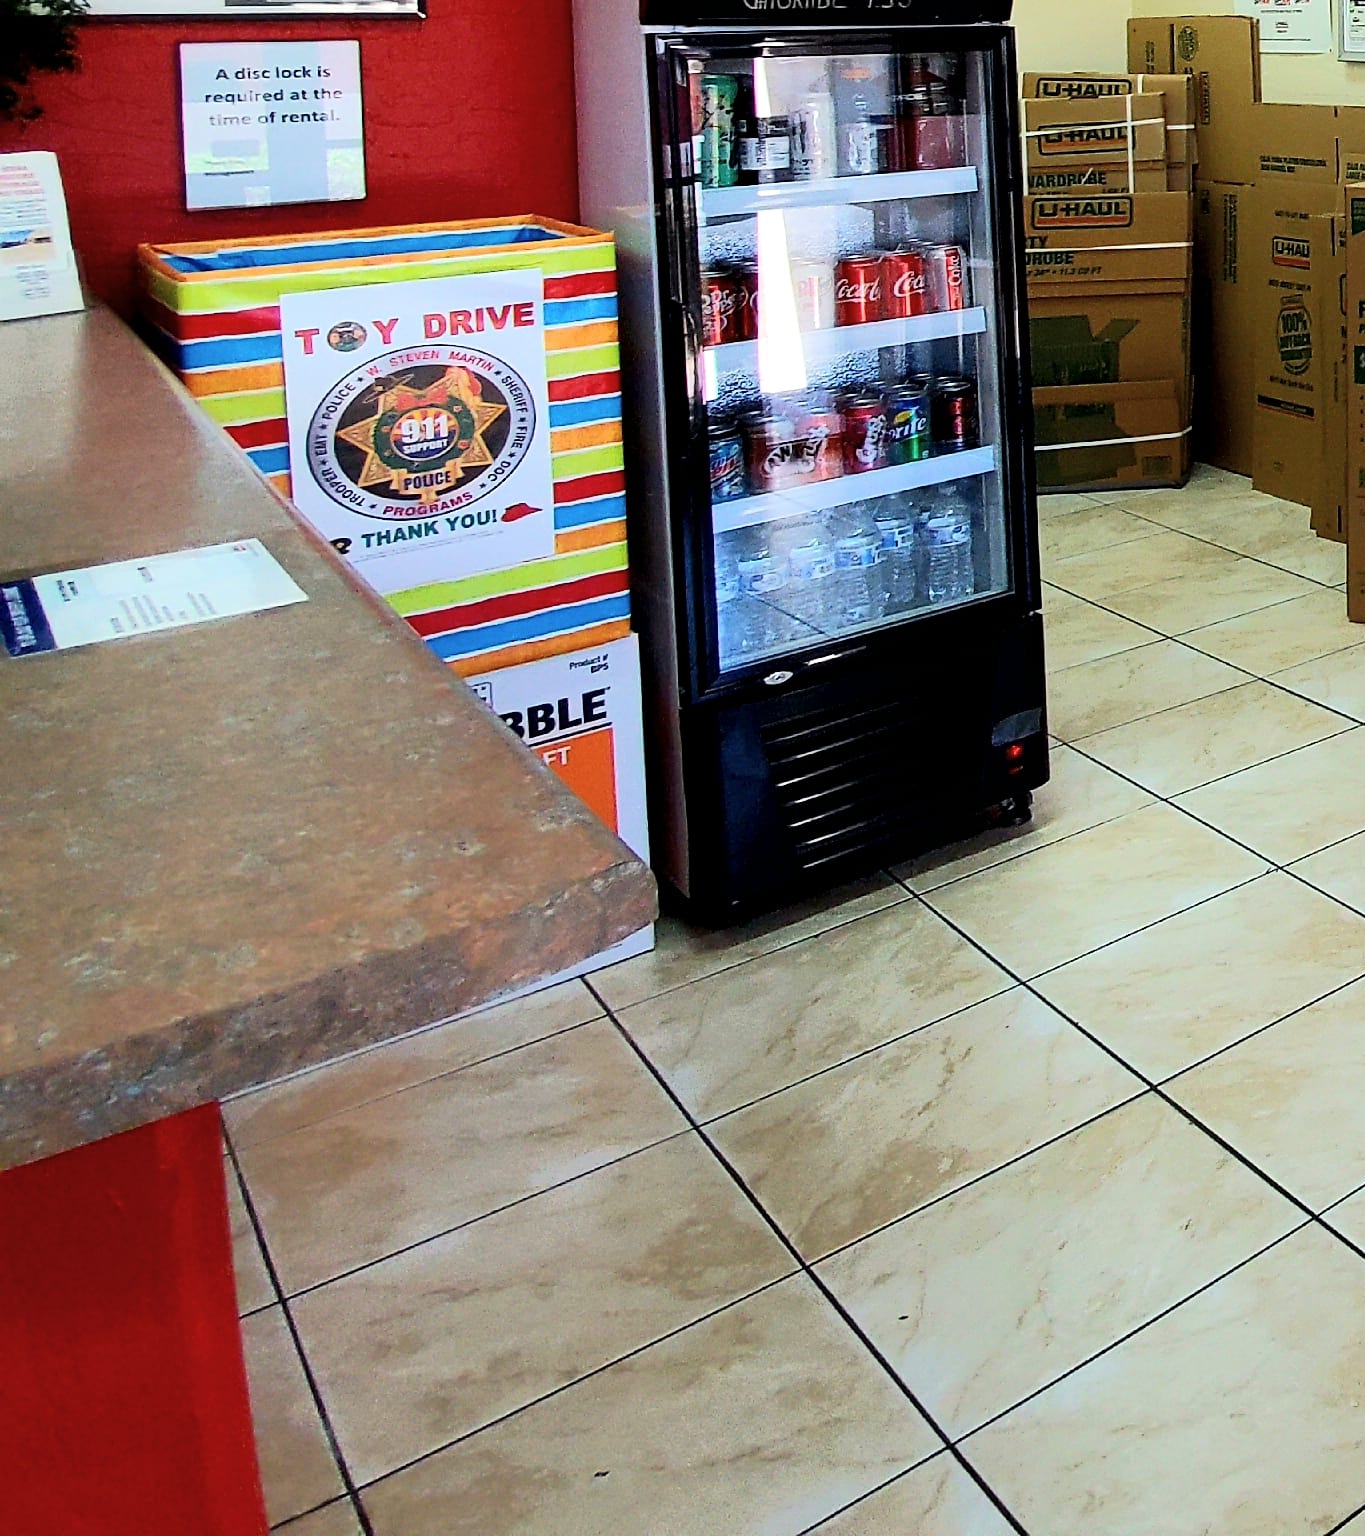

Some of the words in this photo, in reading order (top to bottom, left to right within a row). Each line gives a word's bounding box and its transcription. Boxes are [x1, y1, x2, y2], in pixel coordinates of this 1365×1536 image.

[215, 69, 229, 80] A
[235, 67, 270, 80] disc
[276, 65, 312, 79] lock
[317, 65, 331, 78] is
[205, 90, 284, 109] required
[290, 89, 308, 101] at
[314, 88, 344, 100] the
[1043, 83, 1126, 97] U-HAUL
[209, 114, 251, 126] time
[257, 111, 275, 124] of
[281, 110, 341, 124] rental.
[1038, 201, 1126, 217] U-HAUL
[423, 301, 535, 340] DRIVE
[389, 349, 441, 368] STEVEN
[325, 381, 357, 421] POLICE
[316, 433, 329, 458] EMT
[403, 469, 453, 492] POLICE
[382, 490, 474, 517] PROGRAMS
[360, 520, 441, 549] THANK
[446, 509, 498, 534] YOU!
[542, 746, 572, 765] FT
